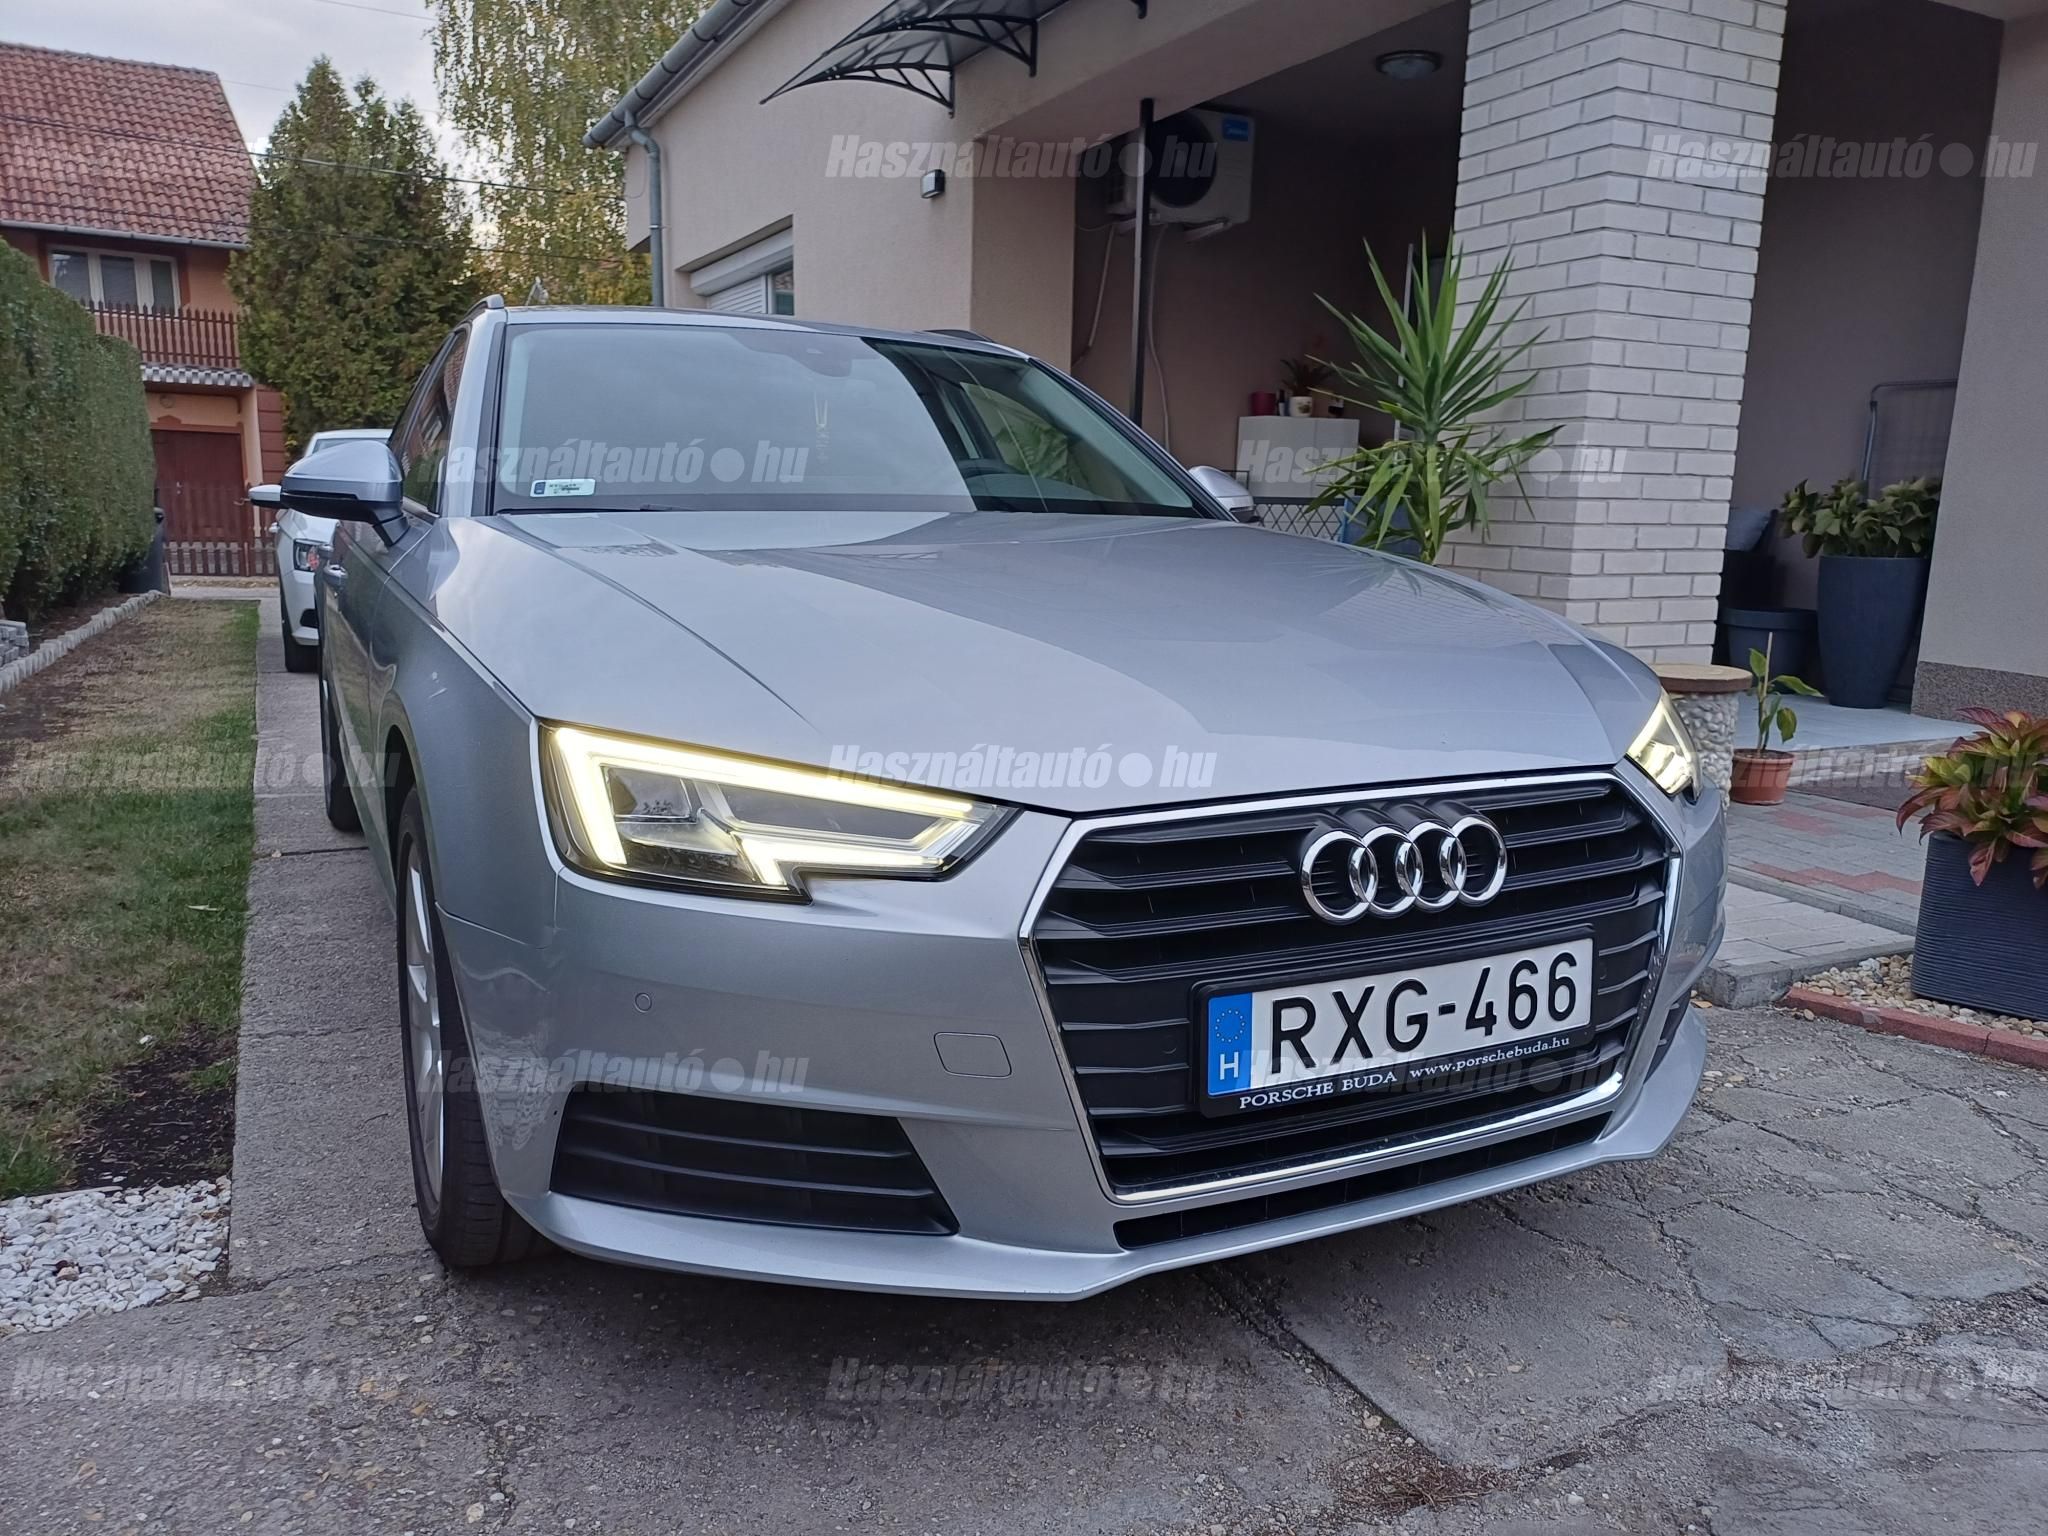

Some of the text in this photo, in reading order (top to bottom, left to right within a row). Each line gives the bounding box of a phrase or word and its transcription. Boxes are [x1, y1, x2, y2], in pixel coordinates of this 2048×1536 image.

[1219, 951, 1577, 1081] H RXG-466
[1239, 1036, 1570, 1109] PORSCHE BUDA www.porschebuda.hu
